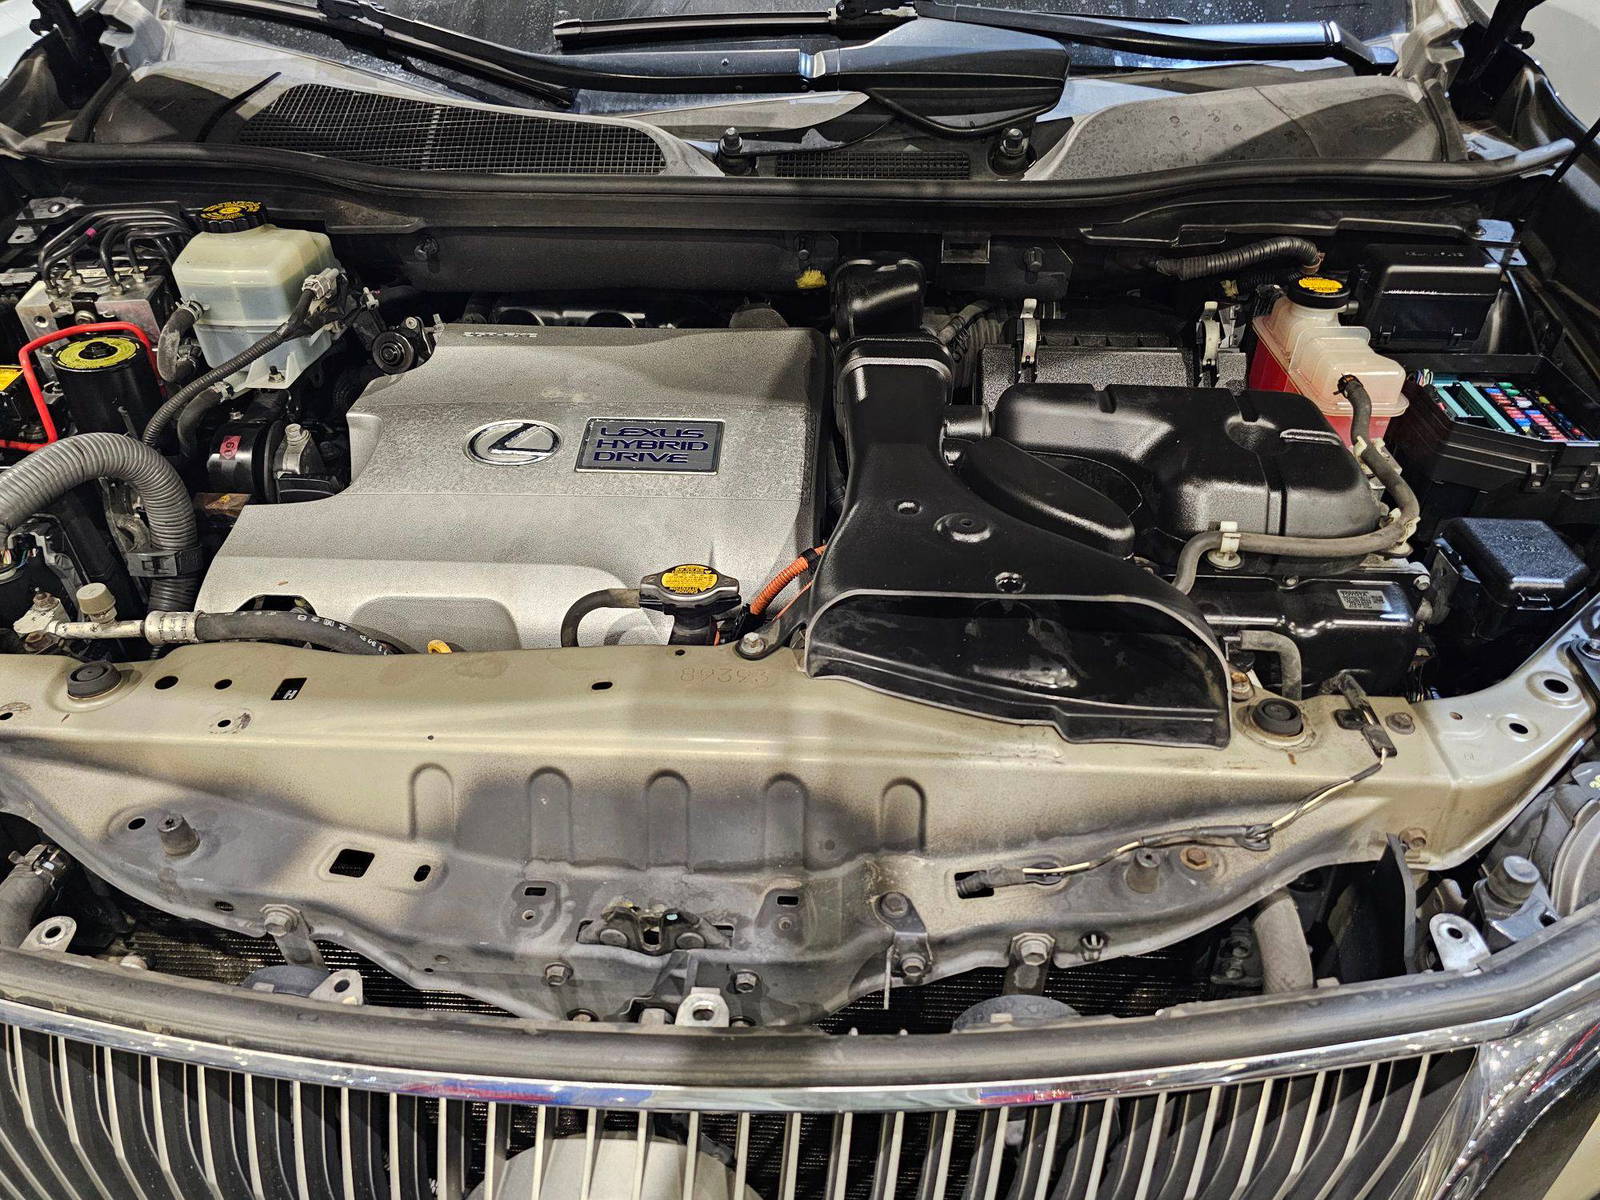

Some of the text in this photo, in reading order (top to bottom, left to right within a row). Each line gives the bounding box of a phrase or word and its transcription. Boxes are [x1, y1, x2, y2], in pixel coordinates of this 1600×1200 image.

[600, 427, 705, 439] LEXUS
[596, 438, 709, 451] HYBRID
[593, 451, 689, 464] DRIVE
